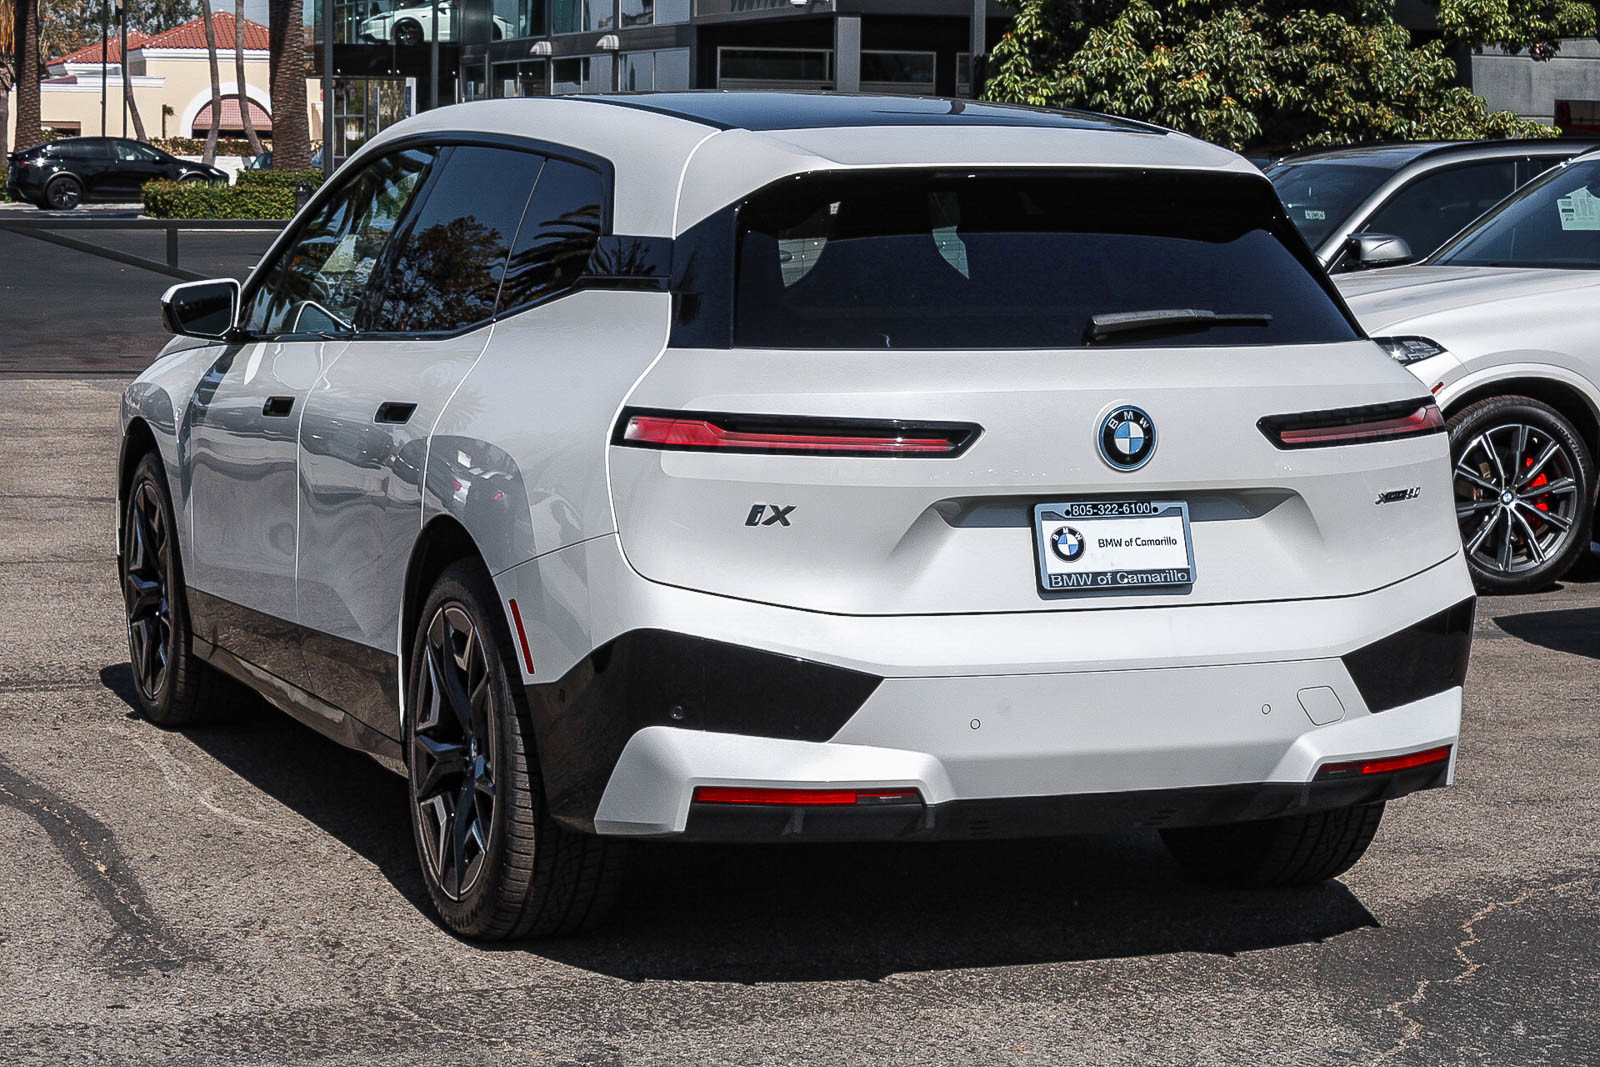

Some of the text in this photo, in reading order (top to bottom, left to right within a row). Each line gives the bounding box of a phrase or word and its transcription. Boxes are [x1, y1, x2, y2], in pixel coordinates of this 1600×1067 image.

[1108, 411, 1149, 430] BMW
[745, 504, 797, 527] iX
[1072, 503, 1150, 516] 805-322-6100
[1098, 536, 1177, 548] BMW of Camarillo
[1051, 570, 1188, 587] BMW of Camarillo
